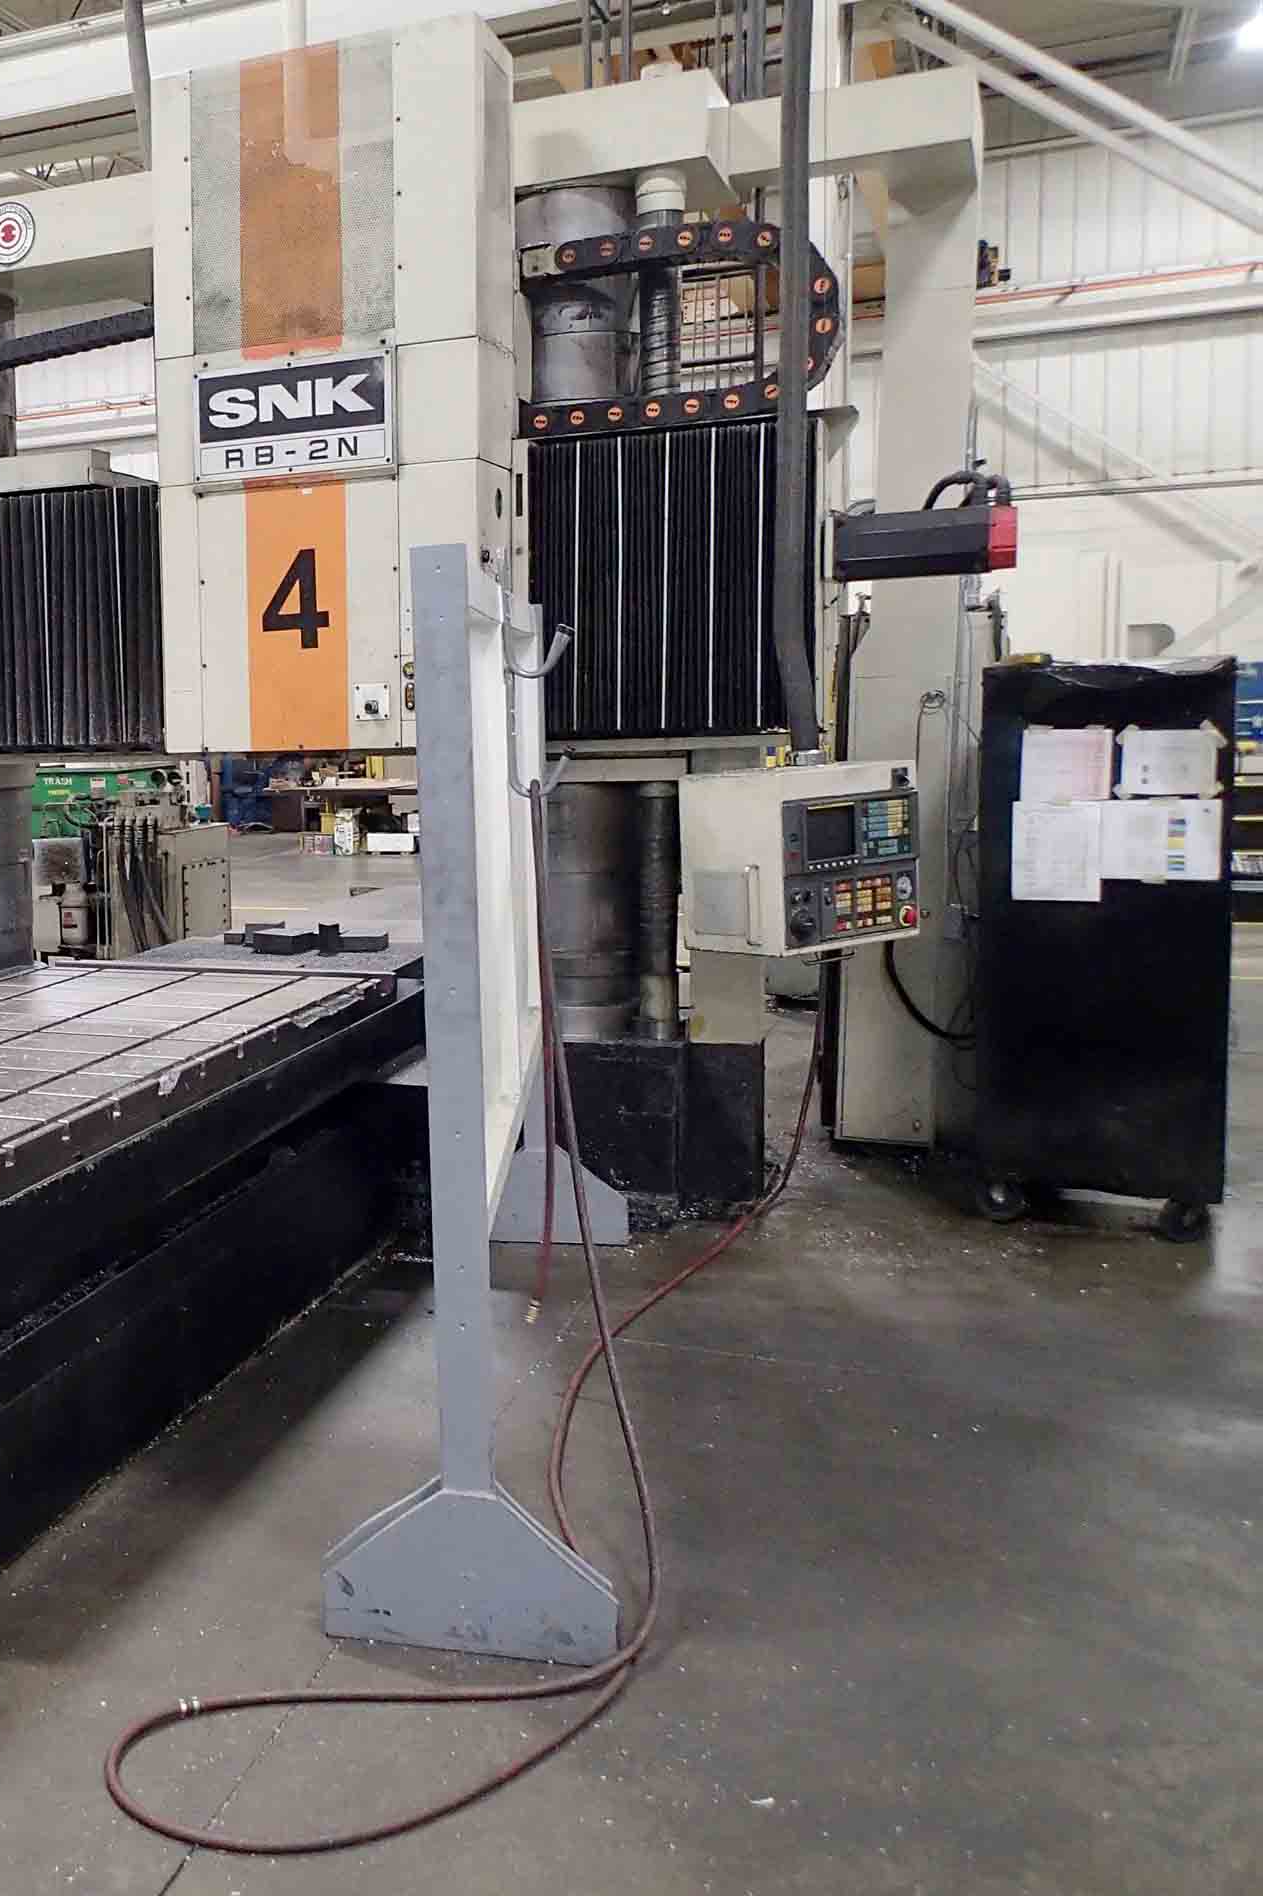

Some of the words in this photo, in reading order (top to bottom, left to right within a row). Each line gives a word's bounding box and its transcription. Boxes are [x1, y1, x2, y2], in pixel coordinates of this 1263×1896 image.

[208, 373, 375, 428] SNK
[224, 436, 360, 469] RB-2N
[262, 548, 330, 649] 4
